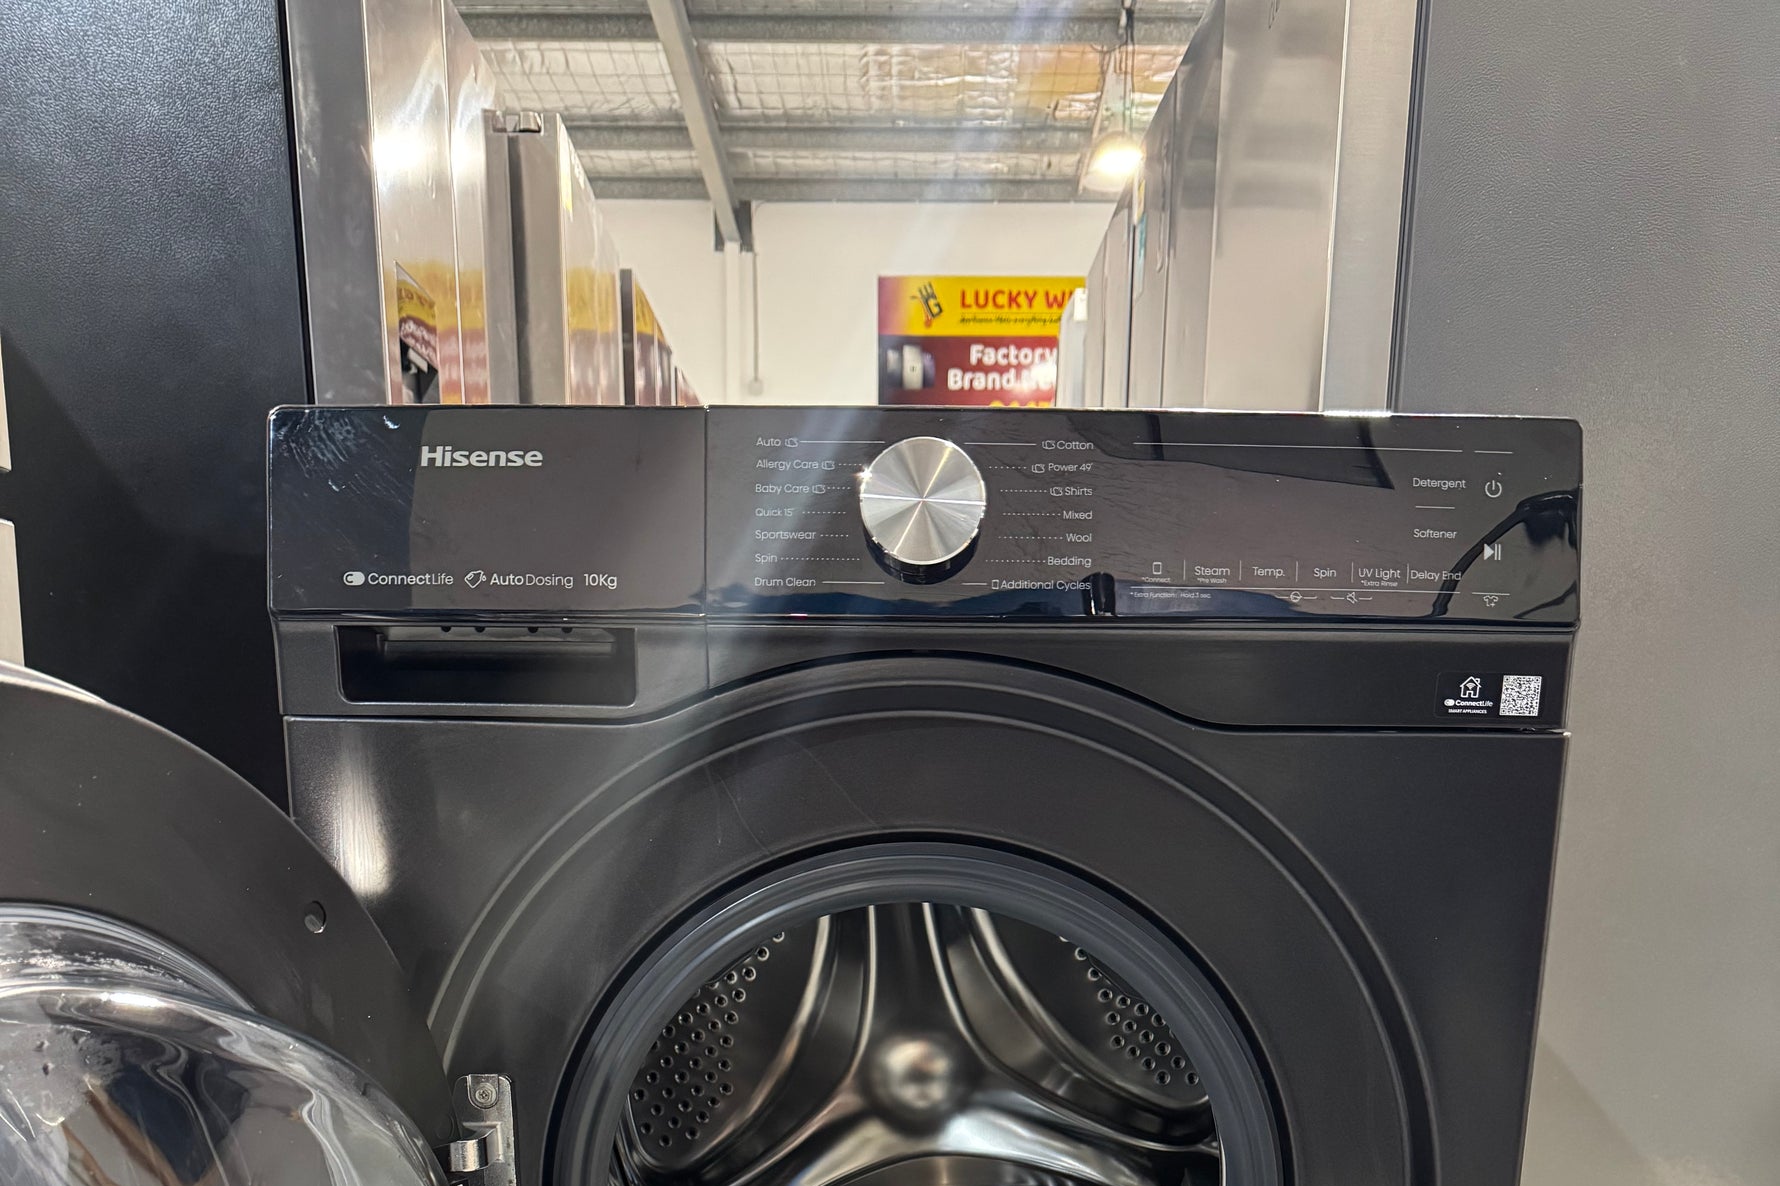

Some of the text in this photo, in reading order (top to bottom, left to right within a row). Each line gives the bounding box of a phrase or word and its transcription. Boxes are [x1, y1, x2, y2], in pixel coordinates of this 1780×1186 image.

[960, 289, 1037, 309] LUCKY
[969, 343, 1058, 369] Factory
[947, 367, 1016, 391] Brand
[756, 437, 781, 447] Auto
[1056, 440, 1094, 450] Cotton
[420, 445, 543, 467] Hisense
[756, 459, 819, 470] Allergy Care
[1048, 463, 1078, 472] Power
[755, 484, 809, 495] Baby Care
[1412, 478, 1467, 490] Detergent
[1065, 486, 1093, 496] Shirts
[755, 508, 783, 517] Quick
[1063, 510, 1093, 520] Mixed
[755, 530, 817, 541] Sportswear
[1066, 533, 1092, 543] Wool
[1413, 528, 1458, 539] Softener
[755, 553, 778, 565] Spin
[1048, 556, 1092, 568] Bedding
[1194, 566, 1231, 577] Steam
[1252, 566, 1285, 579] Temp.
[1313, 567, 1337, 579] Spin
[1358, 568, 1400, 580] UV Light
[1410, 570, 1462, 582] Delay End
[367, 572, 454, 586] ConnectLife
[583, 573, 618, 590] 10Kg
[754, 577, 816, 587] Drum Clean
[1001, 580, 1092, 592] Additional Cycles
[1456, 699, 1493, 707] ConnectLife
